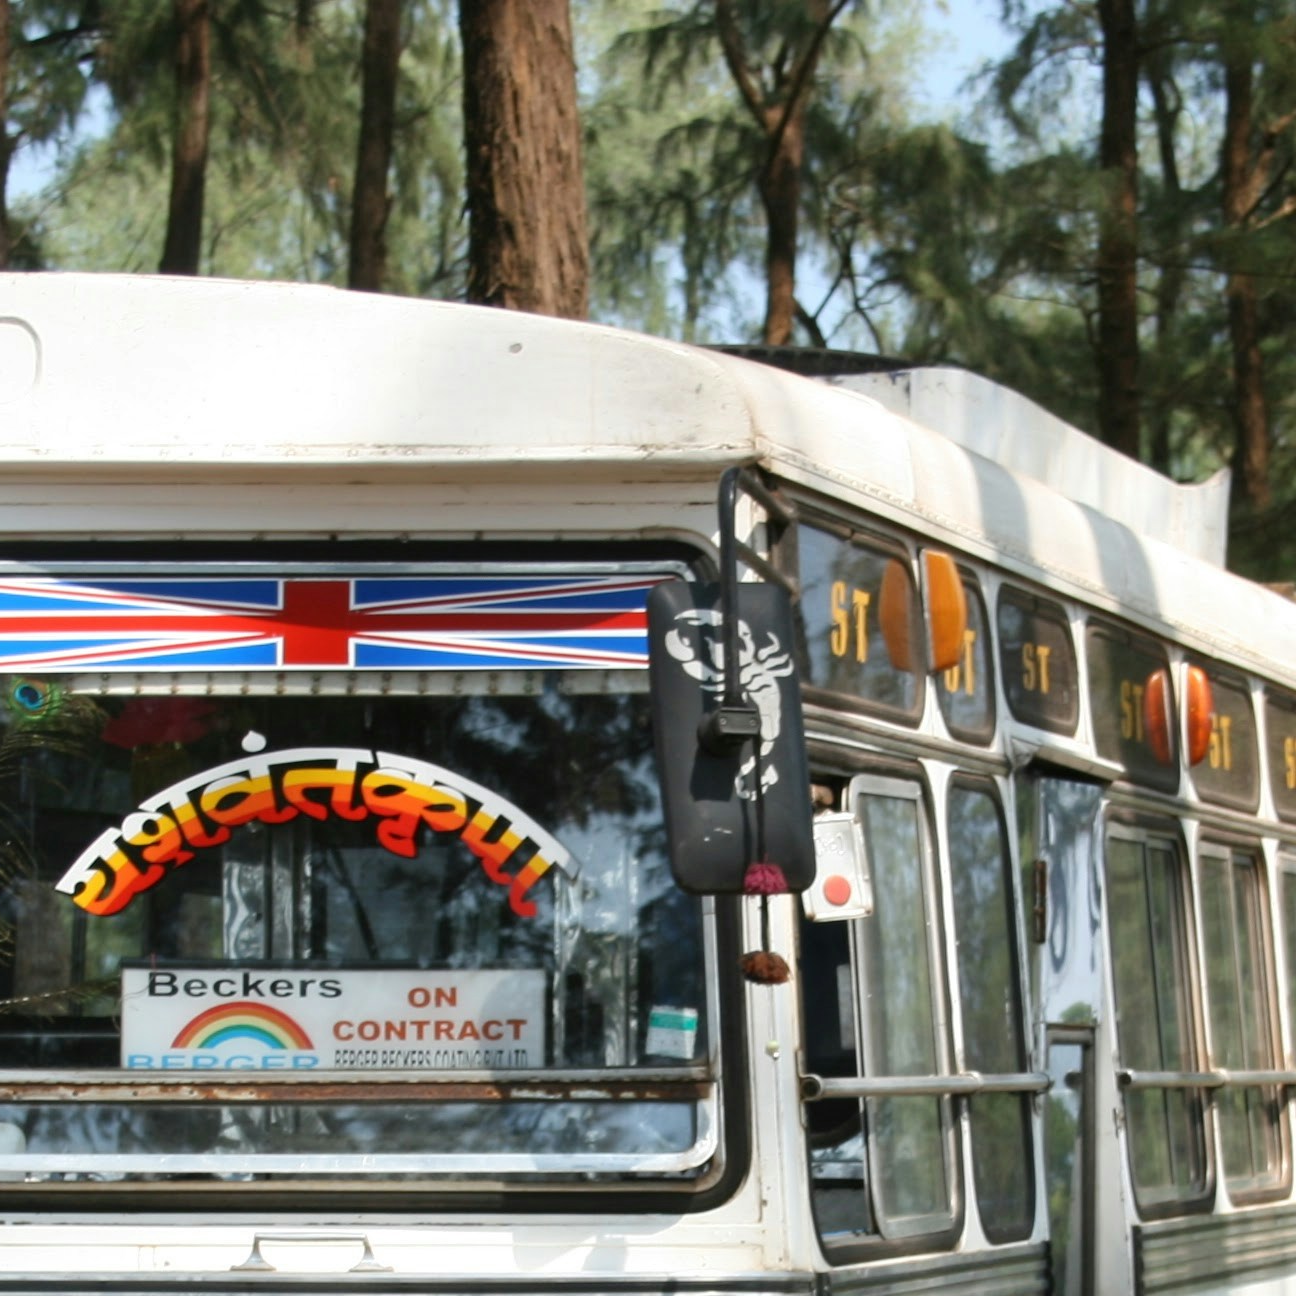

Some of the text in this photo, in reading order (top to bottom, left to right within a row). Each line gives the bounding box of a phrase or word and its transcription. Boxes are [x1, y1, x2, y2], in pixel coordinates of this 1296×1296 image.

[831, 581, 871, 664] ST
[1022, 642, 1050, 694] ST
[1120, 680, 1145, 743] ST
[148, 972, 342, 998] Beckers
[408, 987, 457, 1008] ON
[333, 1019, 527, 1040] CONTRACT
